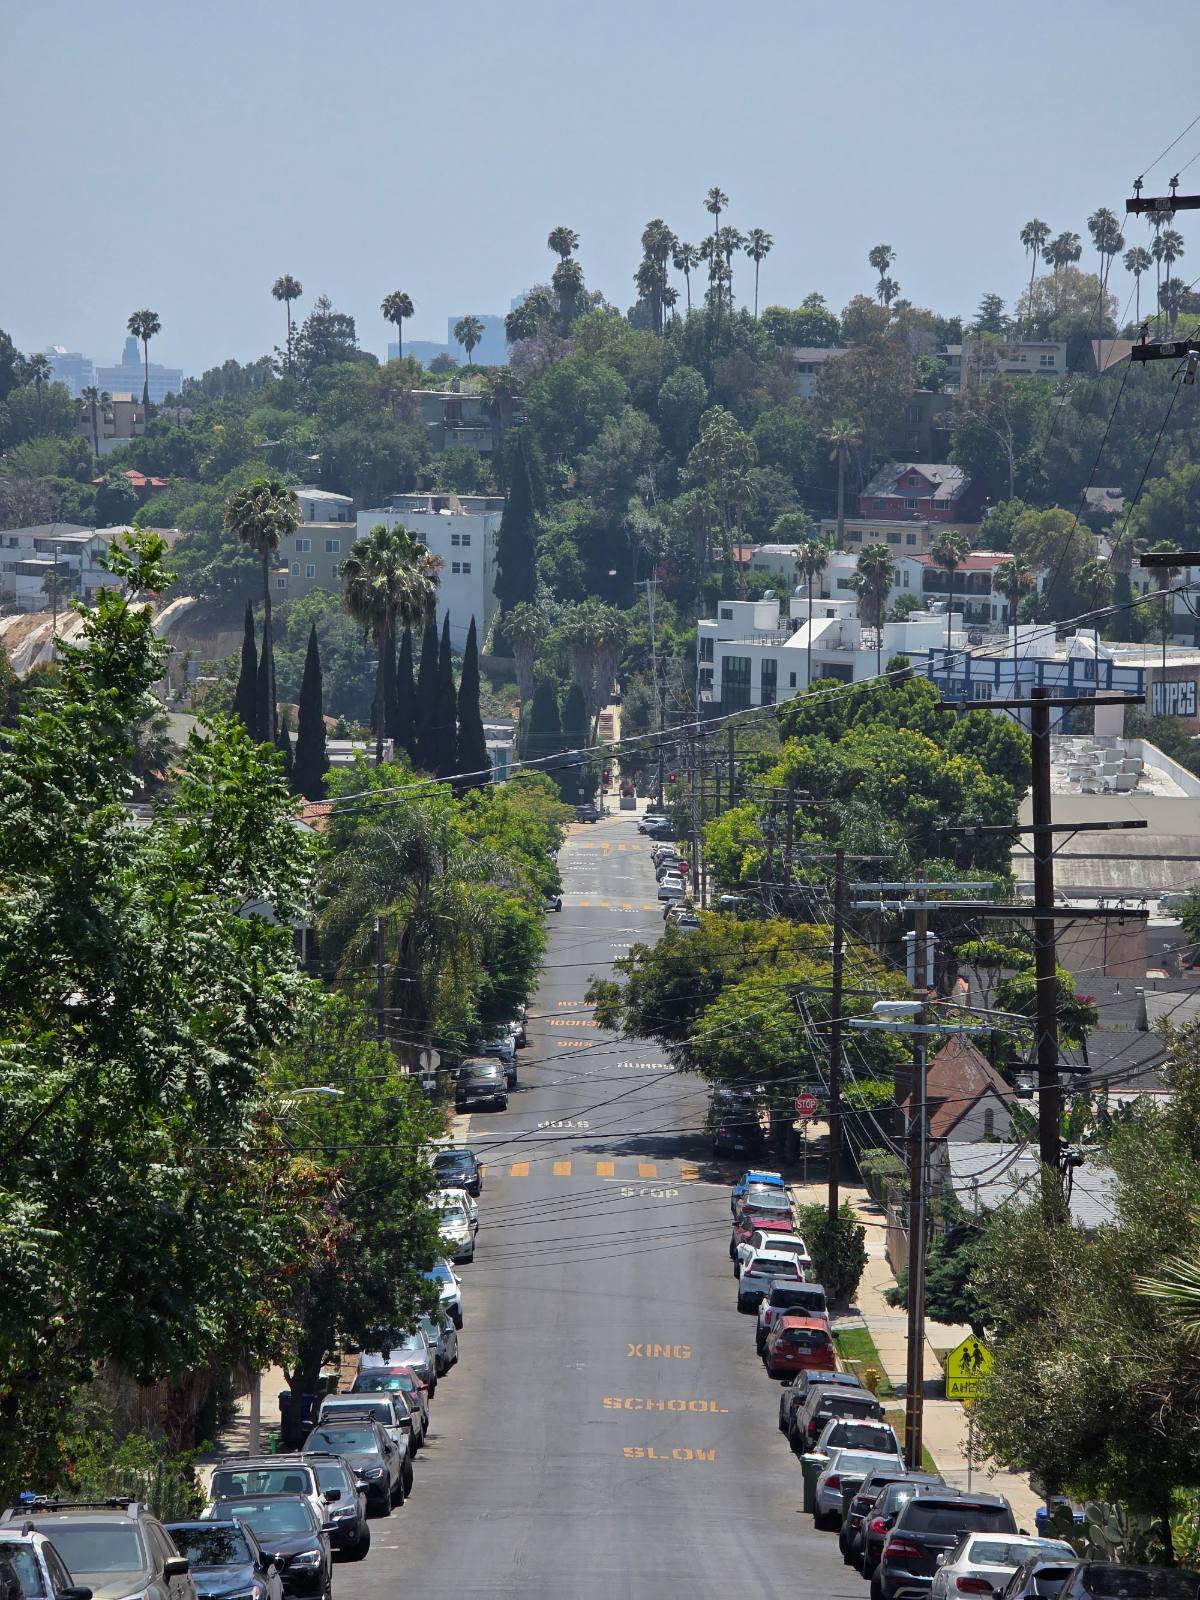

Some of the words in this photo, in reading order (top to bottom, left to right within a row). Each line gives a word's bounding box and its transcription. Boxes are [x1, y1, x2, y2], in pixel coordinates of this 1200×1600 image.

[797, 1100, 815, 1108] STOP
[620, 1187, 678, 1197] STOP
[625, 1343, 692, 1359] XING
[603, 1397, 729, 1412] SCHOOL
[623, 1447, 715, 1461] SLOW
